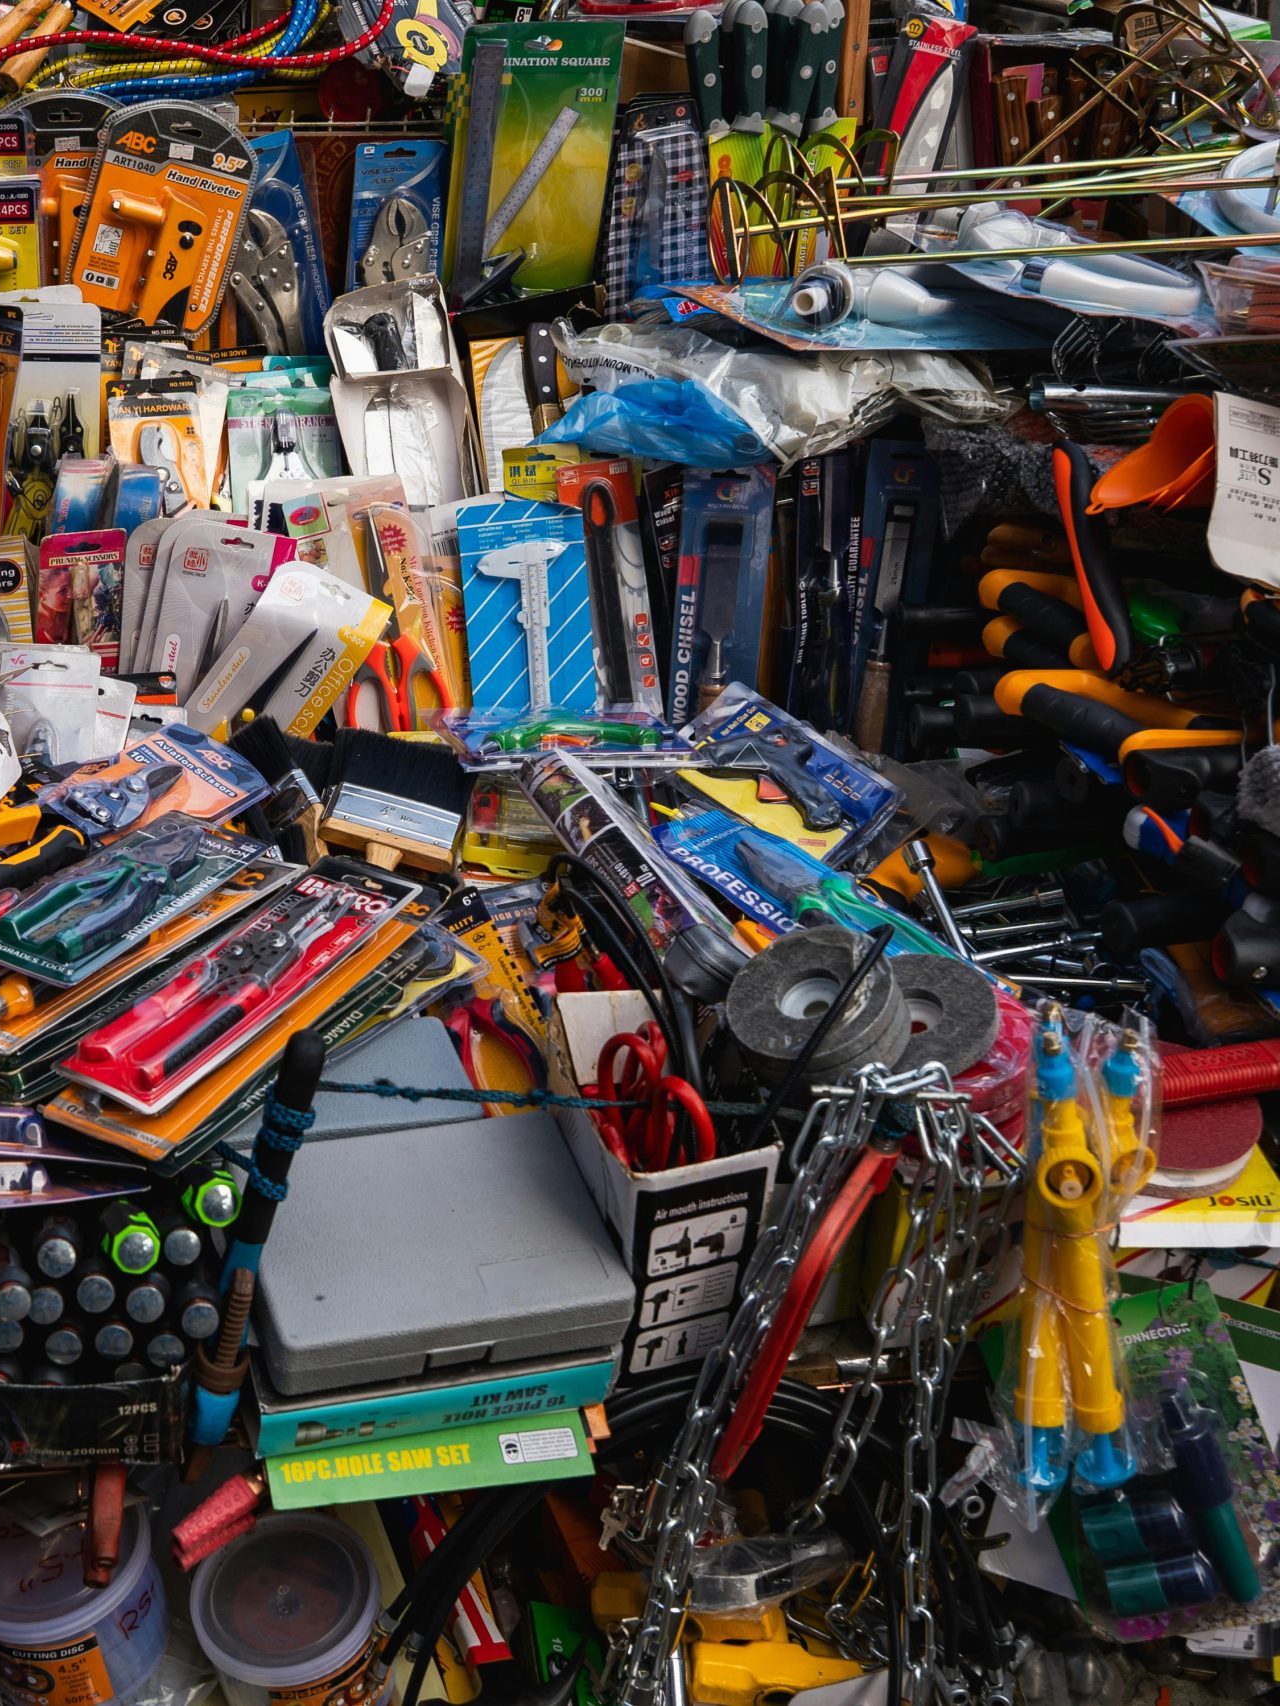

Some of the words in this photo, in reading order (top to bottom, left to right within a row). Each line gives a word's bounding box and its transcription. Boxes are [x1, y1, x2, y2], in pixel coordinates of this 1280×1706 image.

[908, 39, 943, 53] STAINLESS
[943, 48, 961, 57] STEEL
[561, 57, 611, 67] SQUARE
[580, 88, 603, 97] 300
[114, 130, 157, 154] ABC
[112, 154, 156, 174] ART1040
[164, 169, 195, 188] Hand
[194, 179, 242, 199] Riveter
[432, 196, 440, 220] VISE
[8, 224, 28, 235] SET
[431, 223, 440, 244] GRIP
[846, 516, 860, 573] GUARANTEE
[49, 554, 85, 565] PRUNING
[86, 552, 119, 562] SCISSORS
[890, 561, 900, 585] 25mm
[342, 629, 367, 648] K-805
[677, 589, 697, 668] CHISEL
[311, 658, 354, 708] Office
[672, 671, 691, 725] WOOD
[154, 739, 194, 772] Aviation
[193, 767, 237, 798] Scissors
[195, 749, 232, 770] ABC
[462, 892, 477, 906] 6"
[654, 1209, 668, 1221] Air
[670, 1200, 697, 1216] mouth
[699, 1191, 748, 1211] instructions
[1116, 1323, 1191, 1346] CONNECTOR
[471, 1394, 503, 1407] KIT
[507, 1384, 549, 1399] SAW
[118, 1402, 157, 1415] 12PCS
[443, 1410, 486, 1424] HOLE
[492, 1398, 543, 1418] PIECE
[389, 1447, 435, 1470] SAW
[438, 1443, 471, 1466] SET
[12, 1647, 57, 1659] CUTTING
[60, 1644, 85, 1657] DISC
